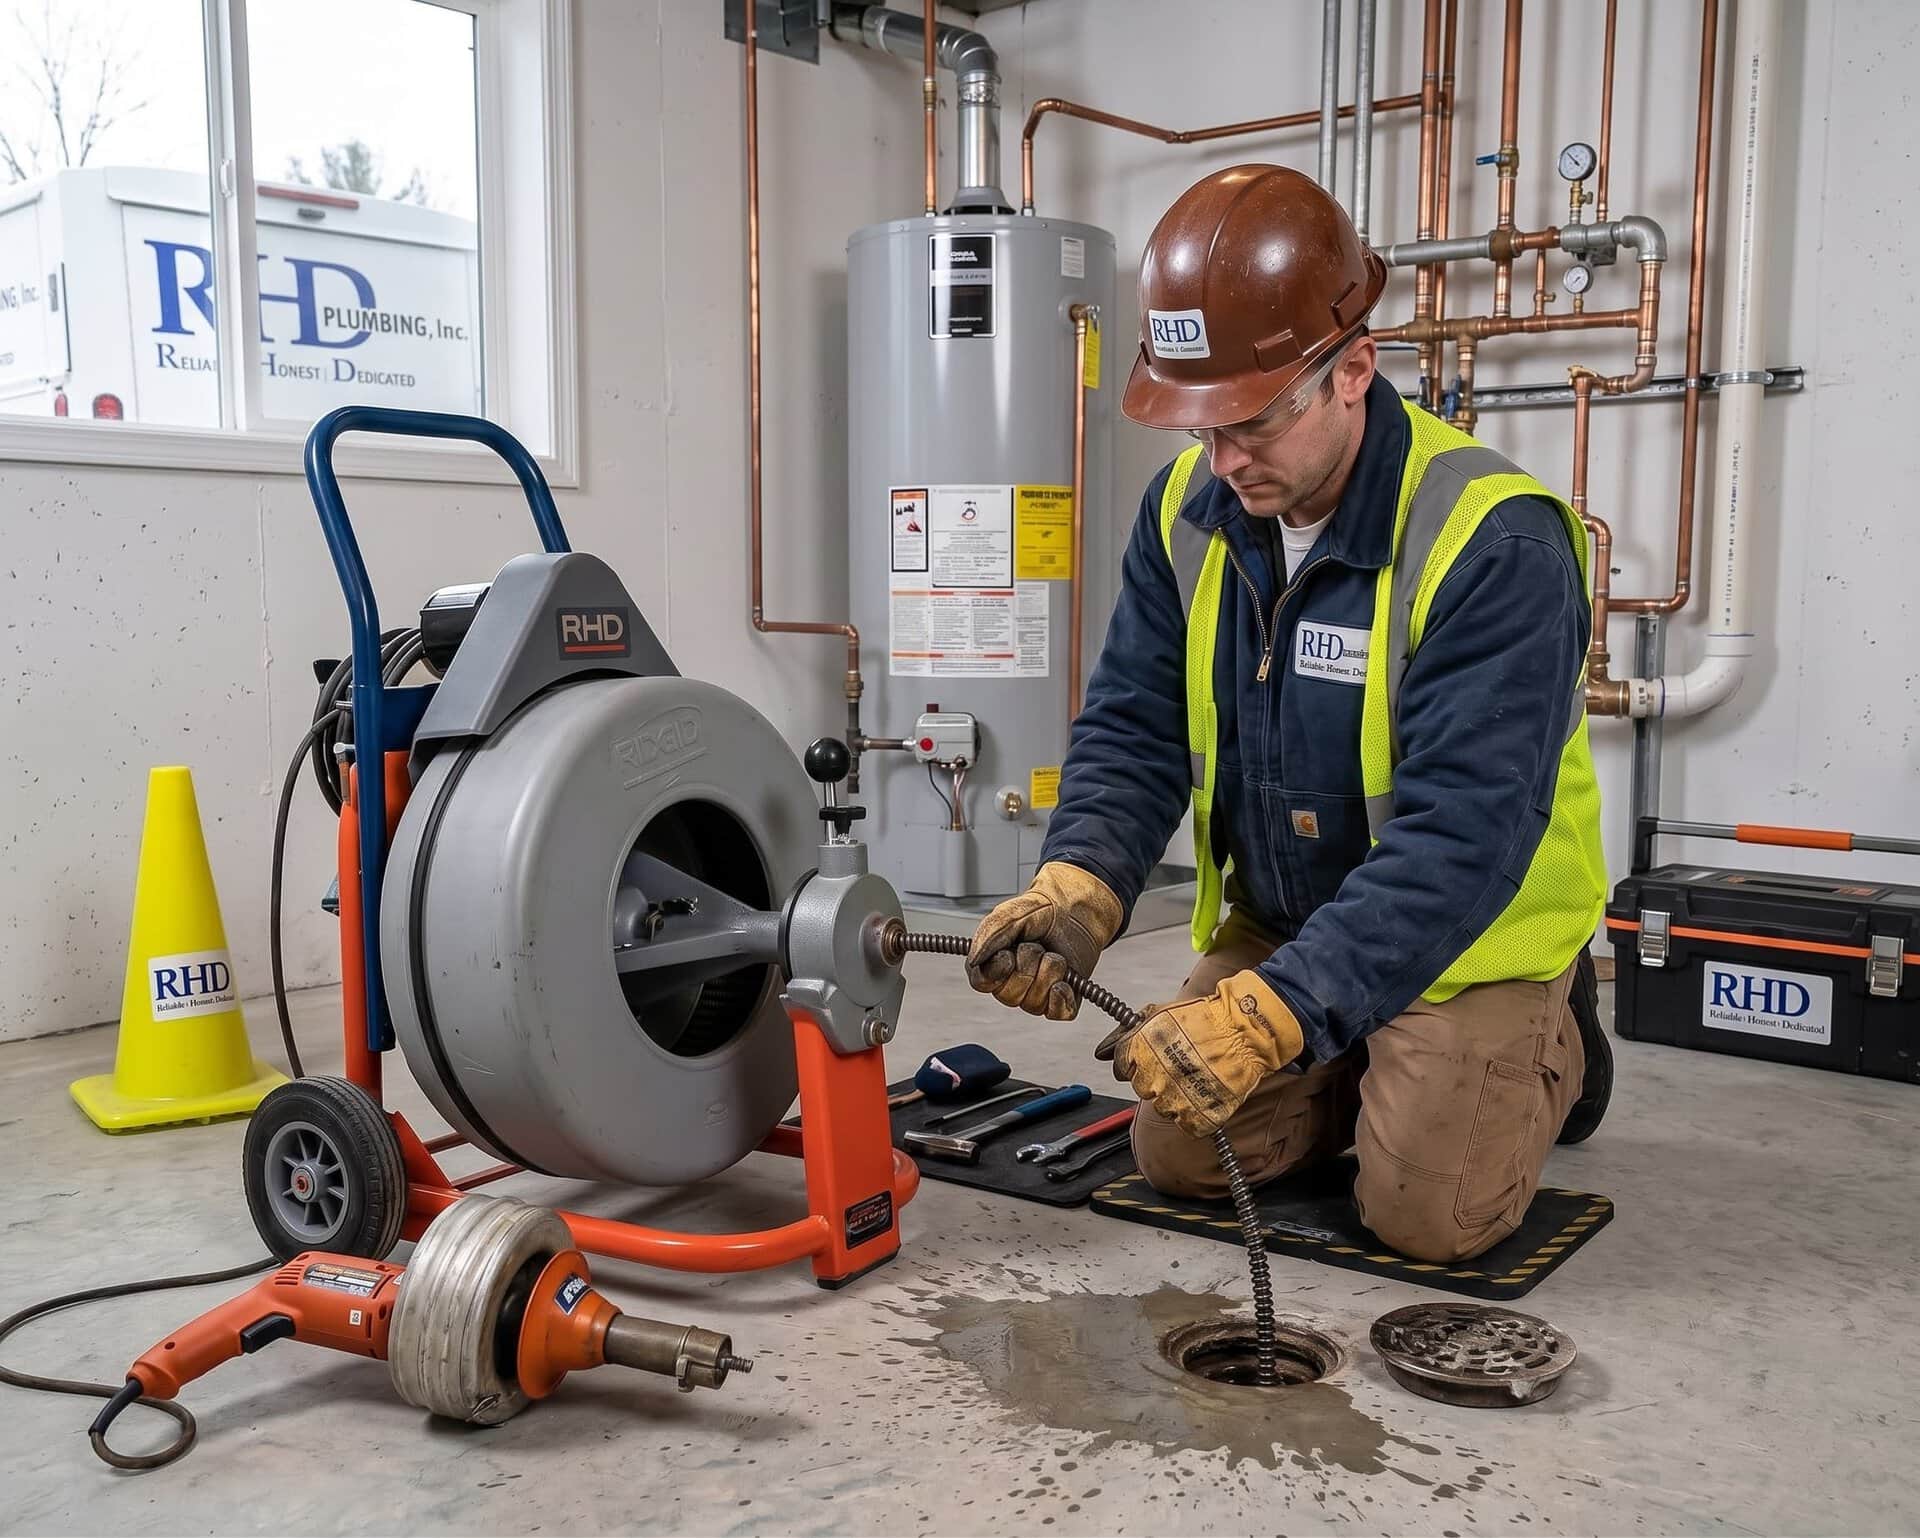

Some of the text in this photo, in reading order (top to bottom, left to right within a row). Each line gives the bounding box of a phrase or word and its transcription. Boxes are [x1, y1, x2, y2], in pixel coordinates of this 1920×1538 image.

[323, 306, 469, 341] PLUMBING, Inc.
[1152, 317, 1201, 343] RHD
[332, 357, 416, 387] DEDICATED
[561, 614, 624, 643] RHD
[1301, 628, 1344, 661] RHD
[154, 961, 230, 1001] RHD
[1709, 971, 1811, 1017] RHD
